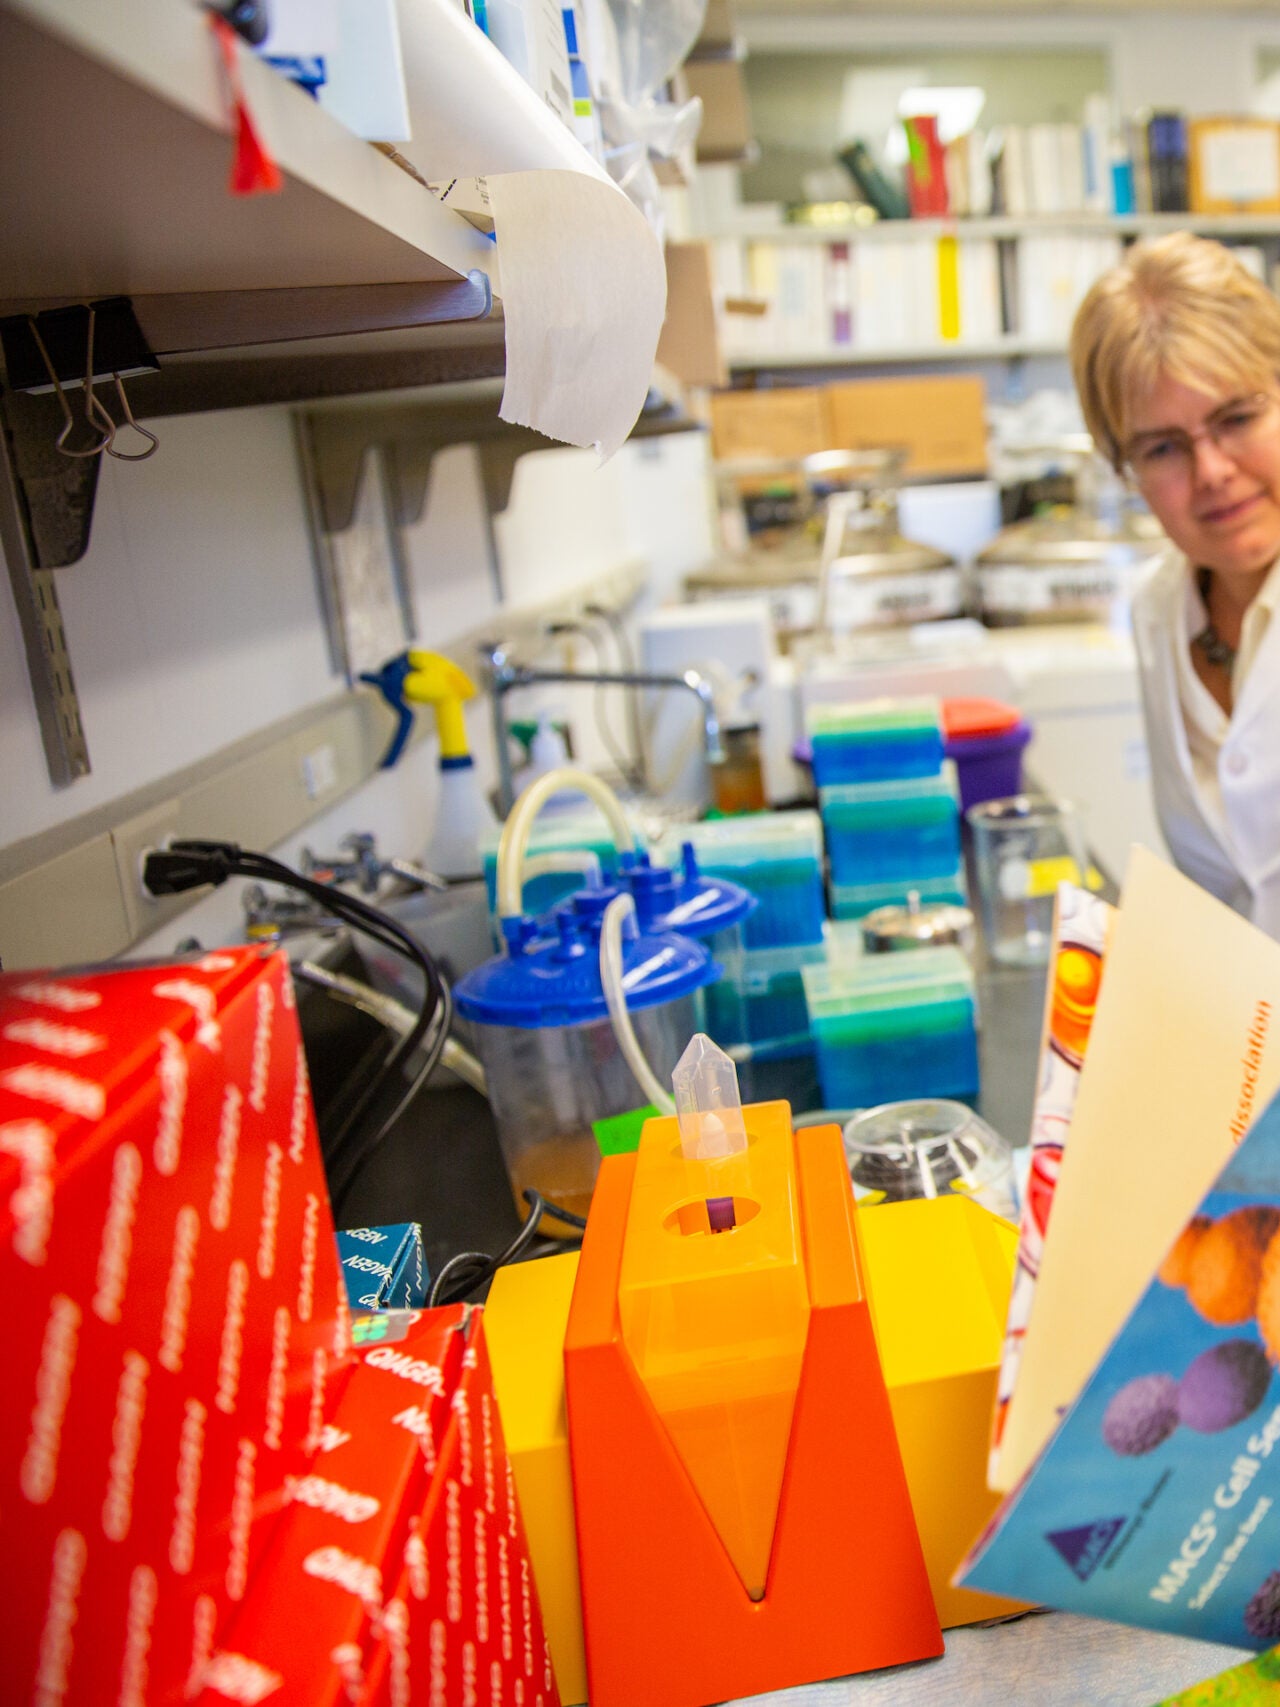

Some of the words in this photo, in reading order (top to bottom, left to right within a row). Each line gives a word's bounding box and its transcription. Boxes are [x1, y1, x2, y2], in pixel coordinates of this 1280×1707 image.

[1229, 1000, 1273, 1146] dissociation
[365, 1347, 446, 1397] QIAGEN
[1213, 1454, 1261, 1508] Cell
[1222, 1533, 1249, 1564] the
[1238, 1496, 1274, 1535] best
